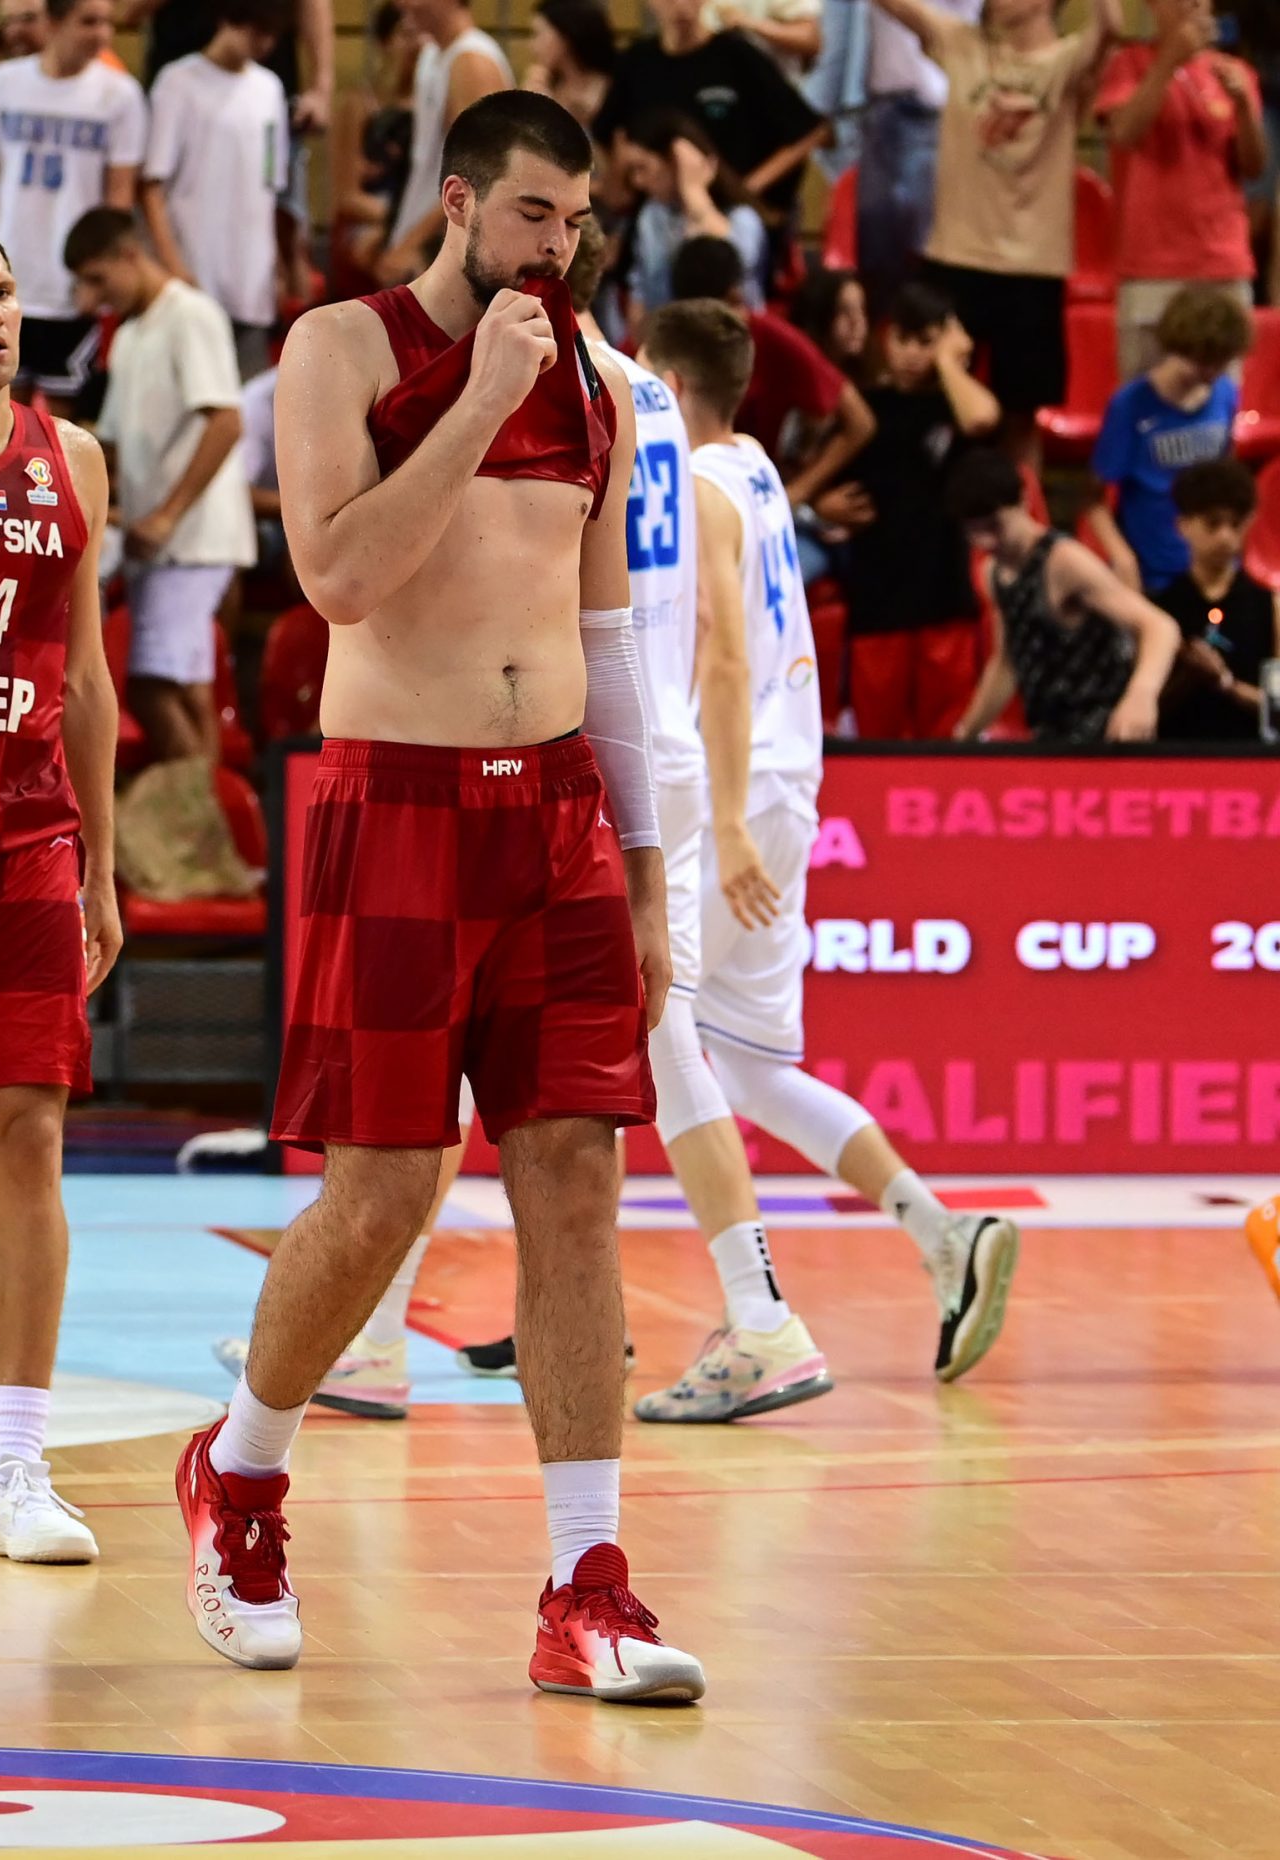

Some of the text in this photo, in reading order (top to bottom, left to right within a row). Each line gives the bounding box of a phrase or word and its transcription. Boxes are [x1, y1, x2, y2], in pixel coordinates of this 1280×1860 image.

[482, 759, 523, 776] HRV
[885, 787, 1280, 839] BASKETB
[804, 918, 972, 975] RLD
[1015, 920, 1157, 971] CUP
